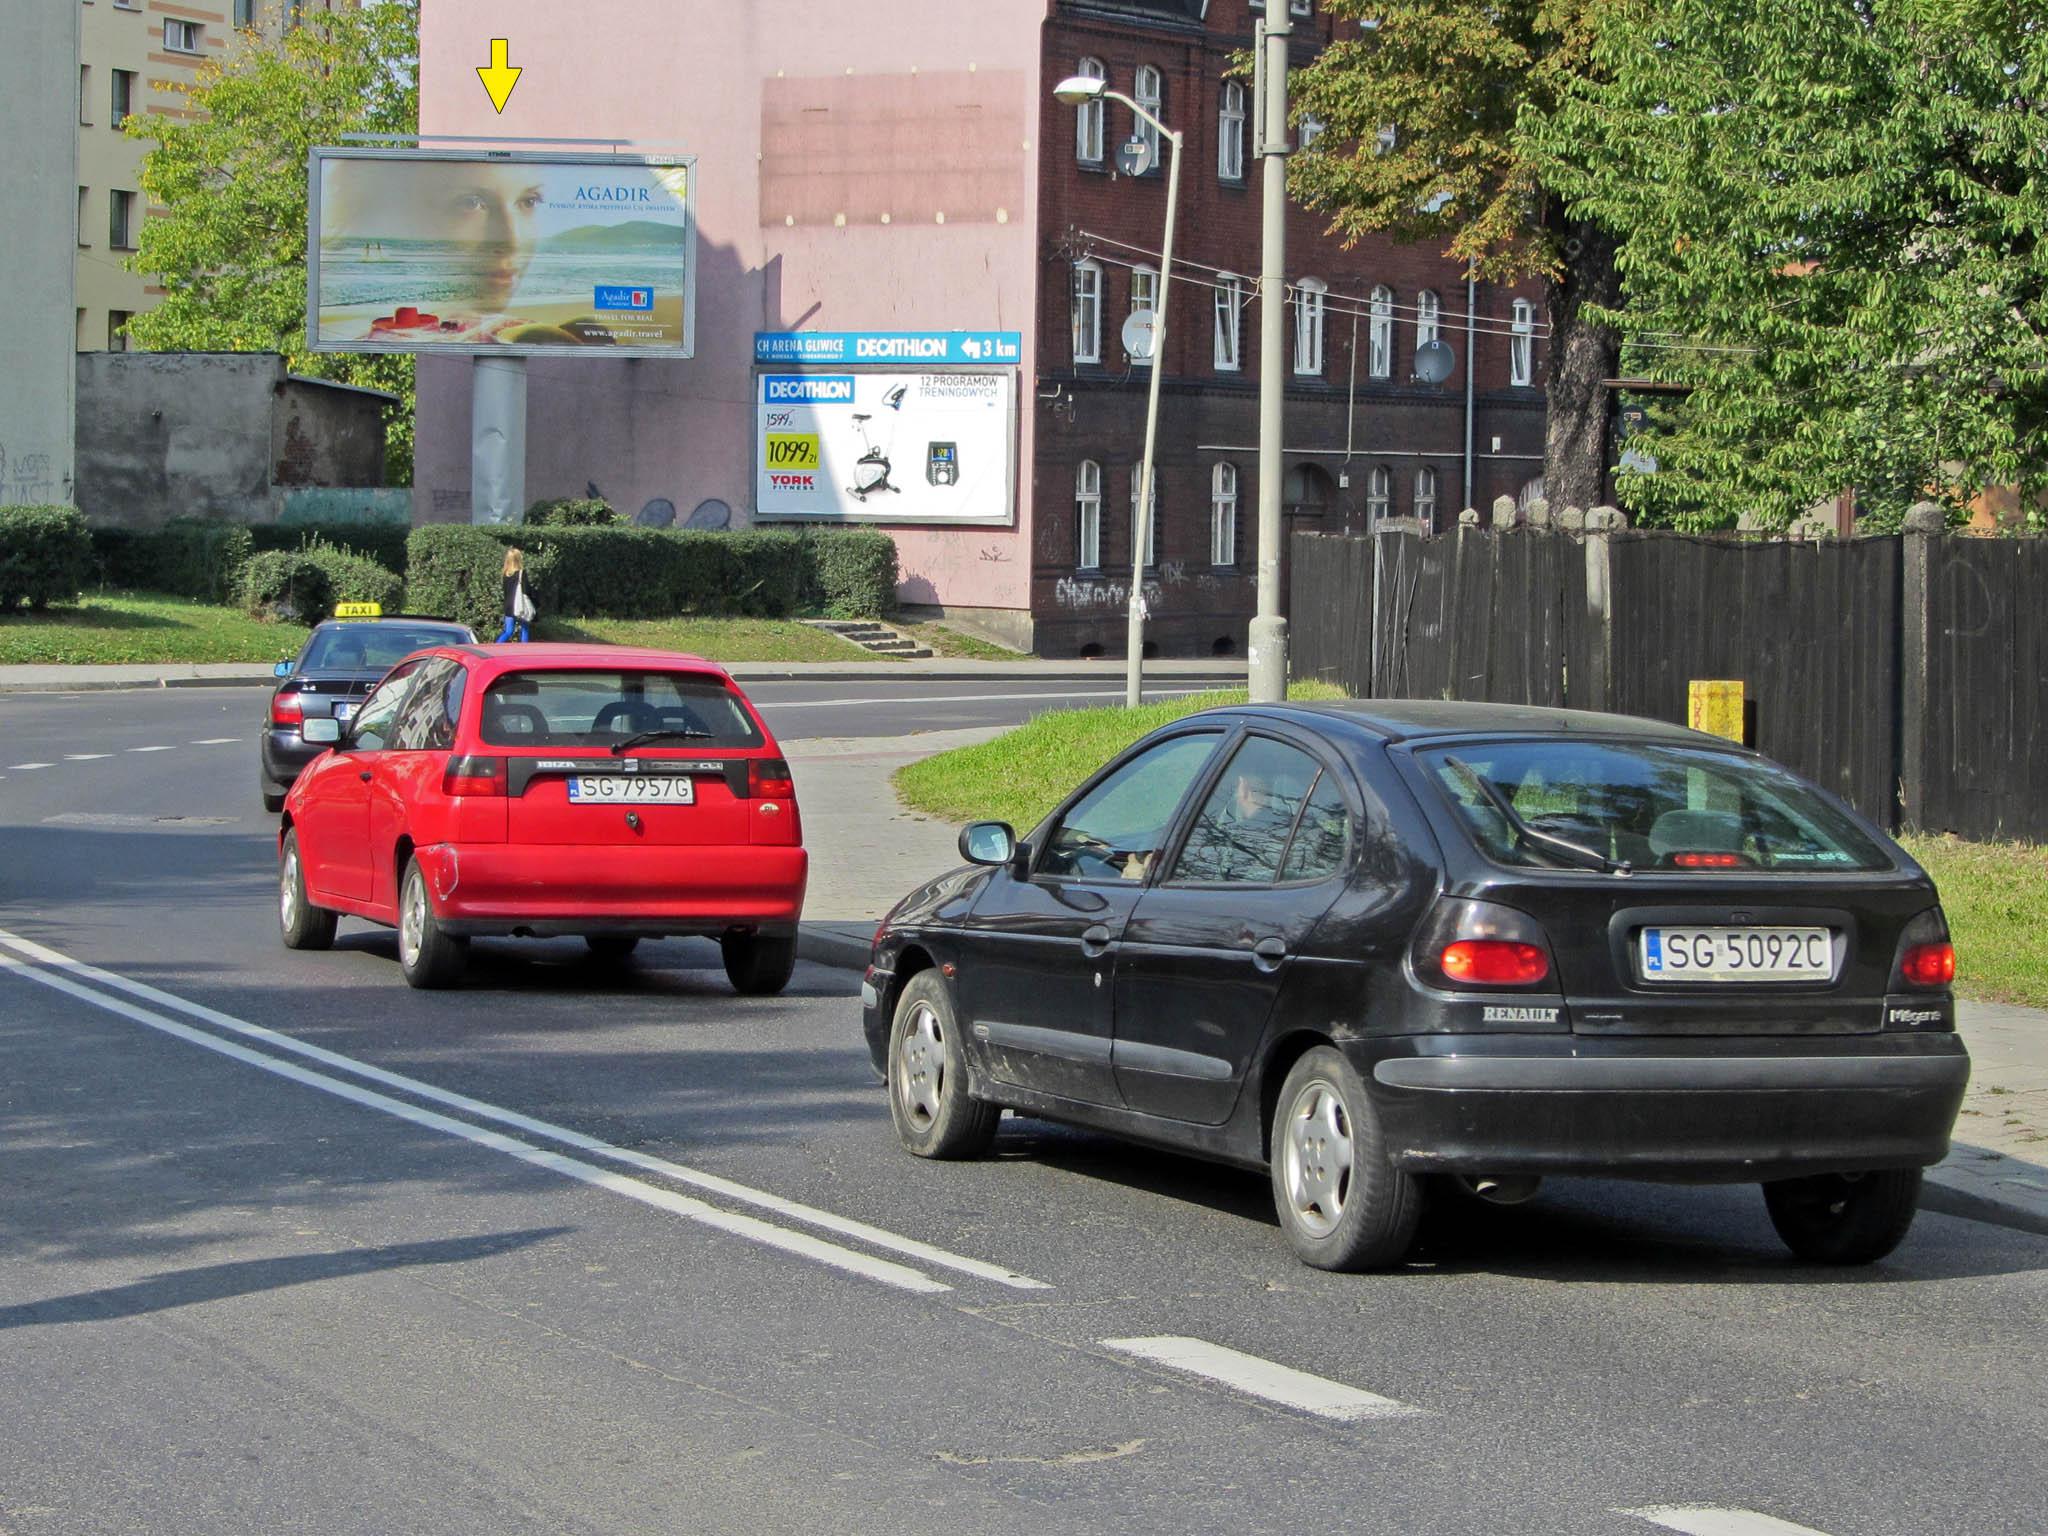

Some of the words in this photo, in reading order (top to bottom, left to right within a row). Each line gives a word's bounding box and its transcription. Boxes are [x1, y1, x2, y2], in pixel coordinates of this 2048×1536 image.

[575, 186, 650, 202] AGADIR
[602, 290, 630, 302] Agadir
[584, 329, 663, 339] www.agadir.travel
[757, 339, 769, 352] CH
[772, 339, 802, 352] ARENA
[805, 339, 844, 352] GLIWICE
[856, 338, 947, 357] DECATHLON
[983, 339, 992, 357] 3
[996, 339, 1017, 357] km
[920, 376, 931, 386] 12
[769, 381, 851, 398] DECATHLON
[919, 387, 998, 397] TRENINGOWYCH
[766, 413, 790, 426] 1599
[769, 441, 810, 463] 1099
[770, 475, 814, 485] YORK
[343, 605, 372, 615] TAXI
[583, 777, 613, 797] SG
[621, 778, 689, 797] 7957G
[1667, 934, 1715, 968] SG
[1726, 934, 1824, 968] 5092C
[1648, 957, 1661, 966] PL
[1483, 1006, 1559, 1022] RENAULT
